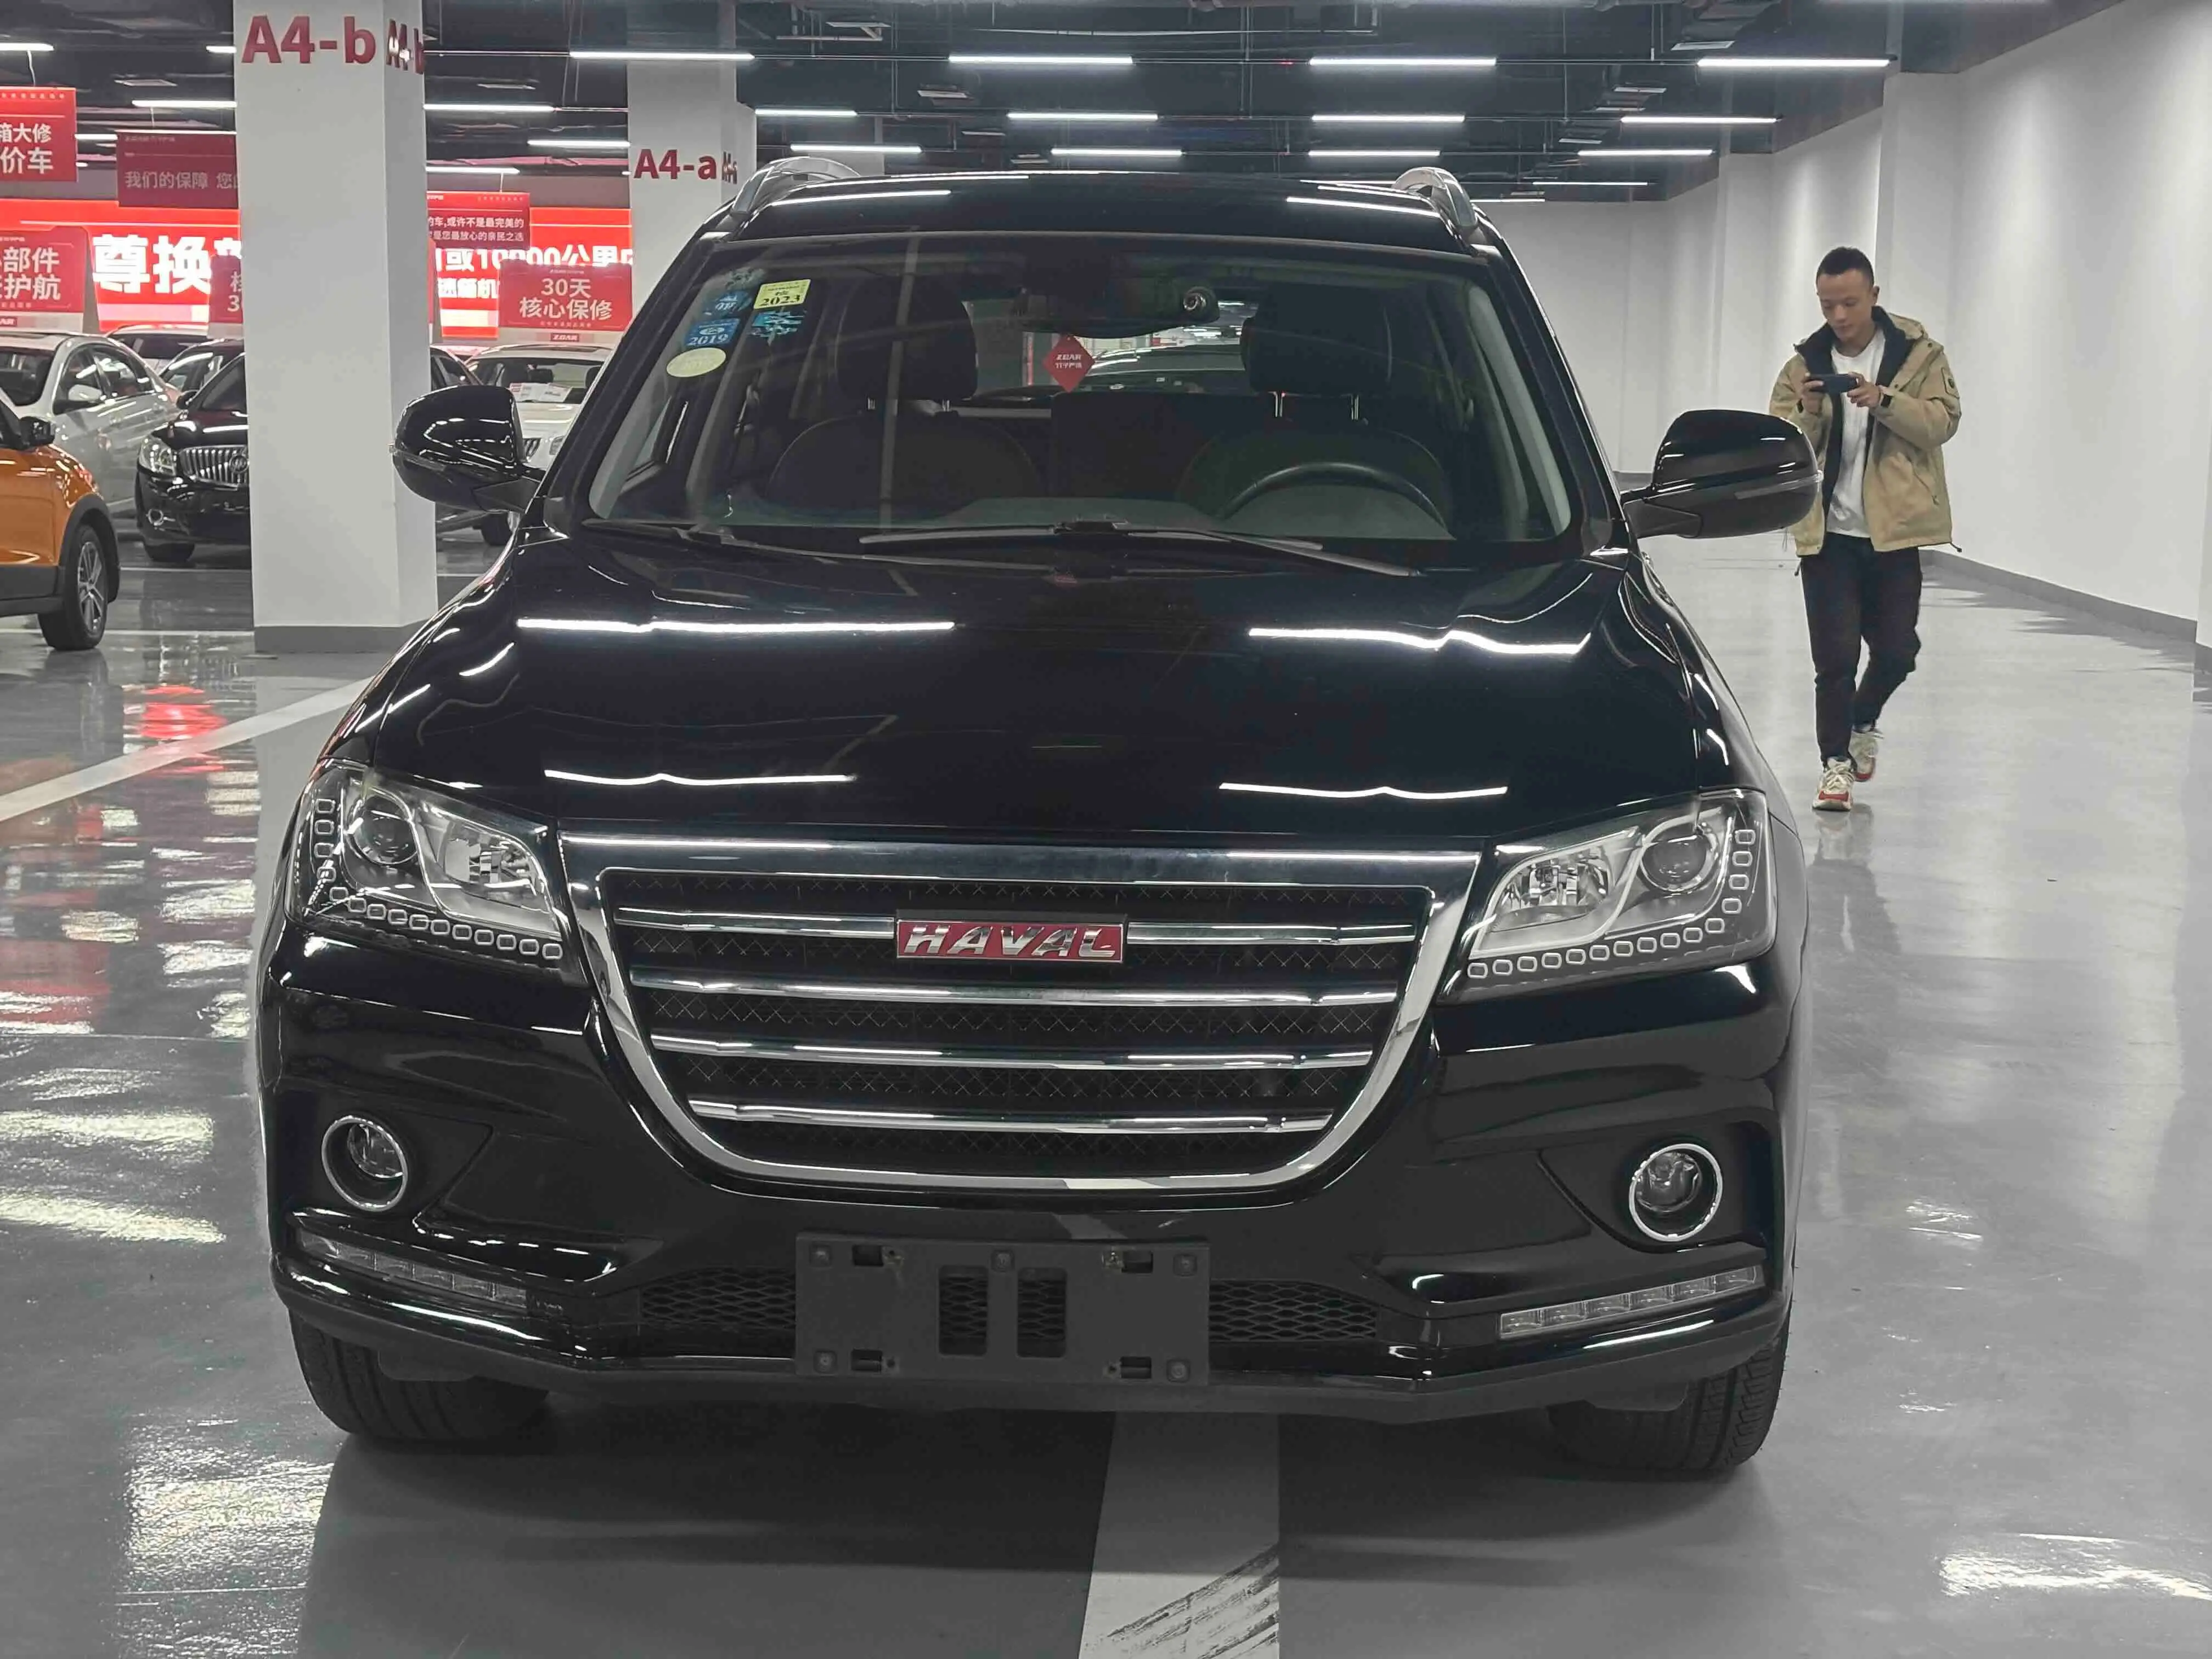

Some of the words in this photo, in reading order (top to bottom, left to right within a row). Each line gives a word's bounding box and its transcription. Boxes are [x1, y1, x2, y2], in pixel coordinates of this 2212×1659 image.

[241, 15, 376, 64] A4-b
[0, 146, 53, 174] 价车
[634, 149, 716, 180] A4-a
[125, 171, 208, 189] 我们的保障
[216, 172, 239, 189] 您
[0, 246, 60, 273] 部件
[0, 273, 61, 301] 护航
[541, 278, 591, 299] 30天
[759, 295, 800, 306] 2023
[520, 297, 612, 321] 核心保修
[686, 334, 729, 346] 2019
[904, 924, 1116, 958] HAVAL
